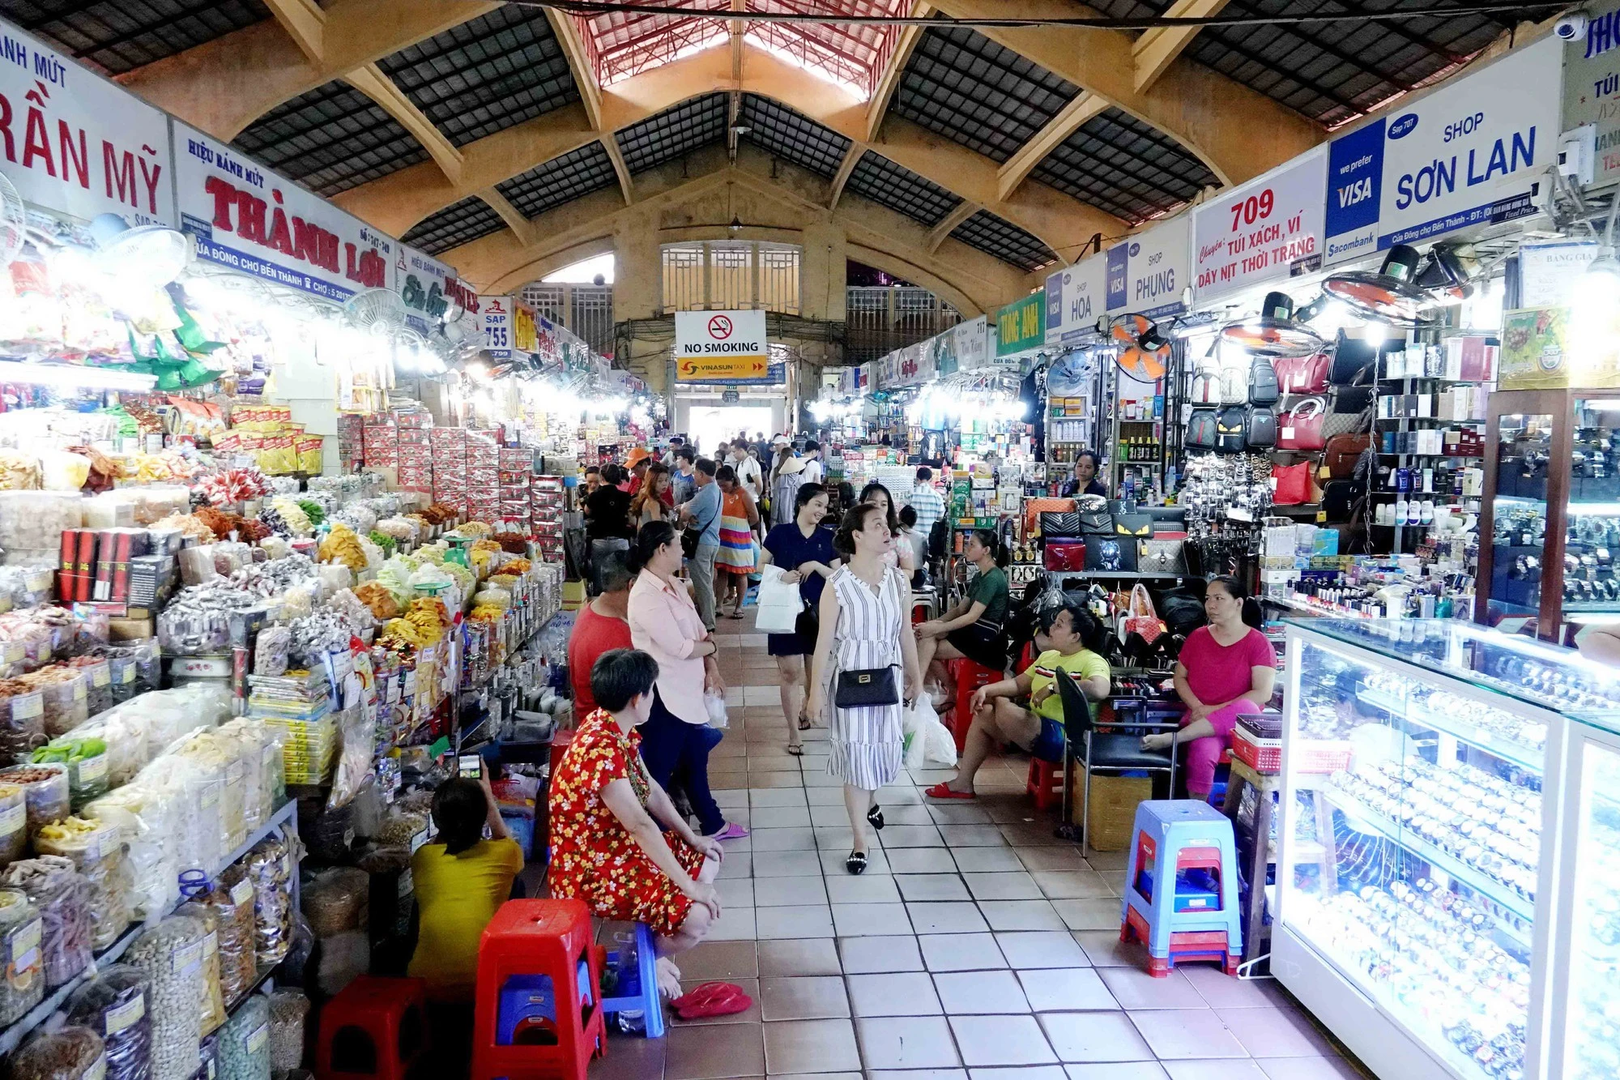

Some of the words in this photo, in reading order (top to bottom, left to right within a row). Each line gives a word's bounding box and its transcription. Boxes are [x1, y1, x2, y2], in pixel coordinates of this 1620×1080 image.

[34, 52, 66, 88] MỨT
[1594, 72, 1618, 98] TÚI
[1404, 118, 1414, 130] 707
[1444, 112, 1484, 143] SHOP
[188, 138, 214, 164] HIỆU
[216, 152, 243, 178] BÁNH
[1340, 164, 1350, 175] we
[1350, 154, 1372, 172] prefer
[1396, 156, 1456, 210] SƠN
[1467, 126, 1536, 187] LAN
[102, 140, 162, 215] MỸ
[1337, 176, 1372, 208] VISA
[1231, 188, 1274, 232] 709
[1504, 208, 1520, 219] Fixed
[1520, 206, 1535, 215] Price
[205, 176, 340, 274] THÀNH
[344, 242, 386, 288] LỢI
[1228, 232, 1245, 256] TÚI
[1288, 210, 1303, 234] VÍ
[1404, 228, 1419, 240] Đông
[1432, 219, 1444, 232] Bến
[1446, 215, 1465, 228] Thành
[1148, 252, 1162, 266] SHOP
[1328, 232, 1374, 258] Sacombank
[212, 246, 239, 266] ĐÔNG
[241, 258, 258, 275] CHỢ
[260, 262, 277, 277] BẾN
[278, 270, 302, 286] THÀNH
[313, 282, 327, 295] CHỢ
[1198, 268, 1217, 288] DÂY
[1220, 262, 1237, 284] NỊT
[1241, 250, 1268, 273] THỜI
[1272, 237, 1315, 264] TRANG
[1077, 282, 1087, 293] SHOP
[1110, 280, 1124, 294] VISA
[1136, 268, 1175, 302] PHỤNG
[1022, 302, 1039, 339] ANH
[1071, 295, 1092, 322] HOA
[485, 327, 507, 346] 755
[685, 344, 702, 353] NO
[705, 342, 758, 352] SMOKING
